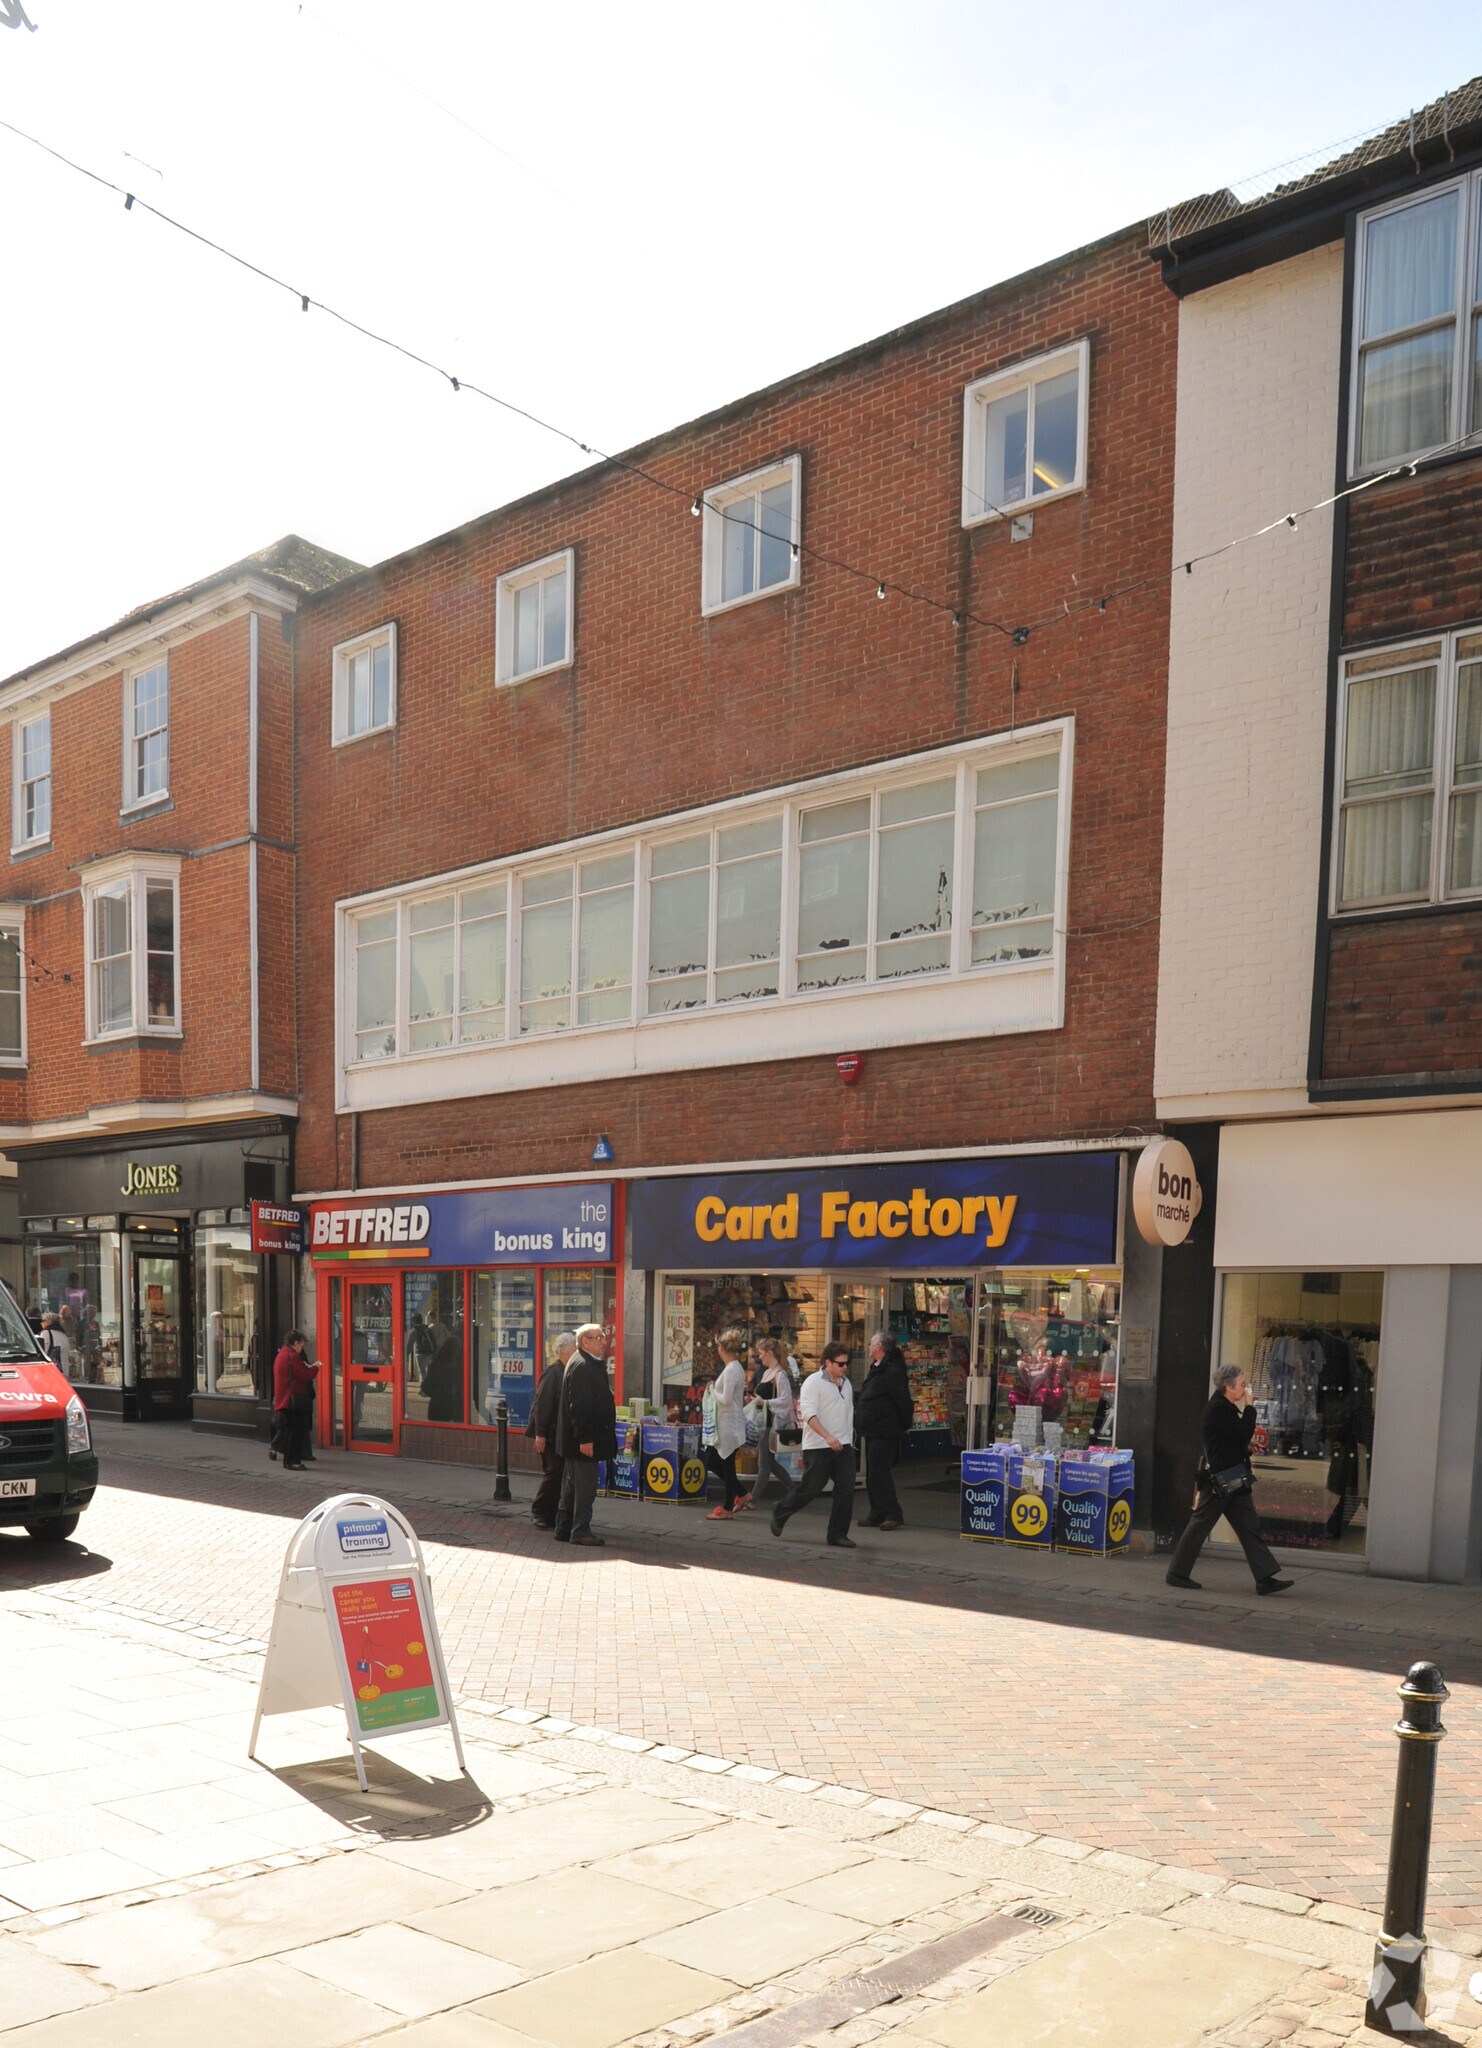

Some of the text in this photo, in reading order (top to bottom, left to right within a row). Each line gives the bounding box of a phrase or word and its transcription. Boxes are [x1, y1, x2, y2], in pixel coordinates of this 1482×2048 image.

[121, 1163, 177, 1195] JONES
[1158, 1163, 1191, 1201] bon
[258, 1207, 300, 1222] BETFRED
[580, 1200, 607, 1222] the
[694, 1188, 1018, 1247] Card Factory
[1157, 1203, 1190, 1223] marché
[313, 1205, 430, 1245] BETFRED
[291, 1232, 300, 1241] the
[494, 1227, 606, 1253] bonus king
[258, 1239, 300, 1251] bonus king
[668, 1289, 691, 1306] NEW
[354, 1316, 391, 1328] BETFRED
[1061, 1324, 1069, 1338] 5
[502, 1361, 524, 1373] £150
[617, 1466, 630, 1476] and
[2, 1482, 28, 1495] CKN
[614, 1476, 633, 1488] Value
[965, 1489, 1000, 1506] Quality
[973, 1504, 992, 1517] and
[1016, 1503, 1044, 1528] 99p
[1062, 1499, 1102, 1519] Quality
[969, 1517, 996, 1531] Value
[1070, 1516, 1090, 1529] and
[345, 1537, 384, 1547] training
[1065, 1530, 1095, 1544] Value
[341, 1605, 360, 1613] really
